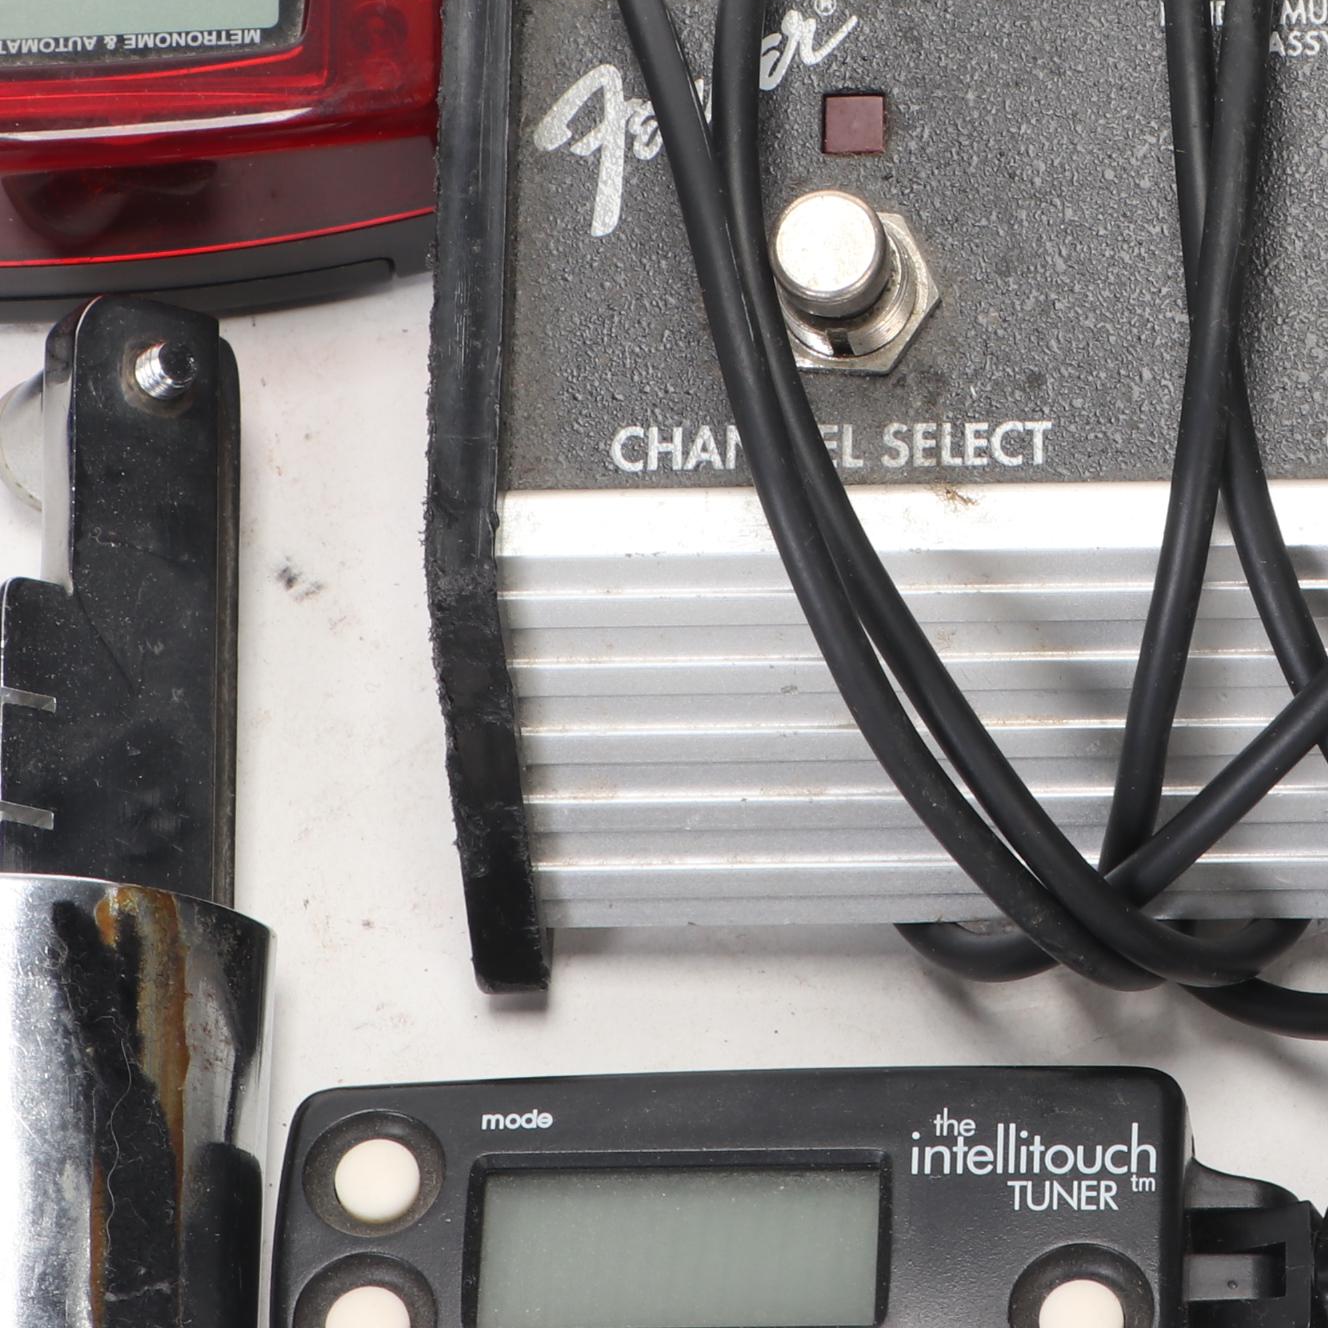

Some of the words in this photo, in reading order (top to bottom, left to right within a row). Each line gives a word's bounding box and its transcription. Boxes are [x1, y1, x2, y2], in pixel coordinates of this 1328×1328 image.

[103, 34, 118, 50] &
[123, 28, 261, 50] METRONOME
[880, 420, 1053, 469] SELECT
[481, 1108, 554, 1130] mode
[934, 1107, 976, 1137] the
[911, 1122, 1157, 1175] intellitouch
[1007, 1180, 1119, 1211] TUNER
